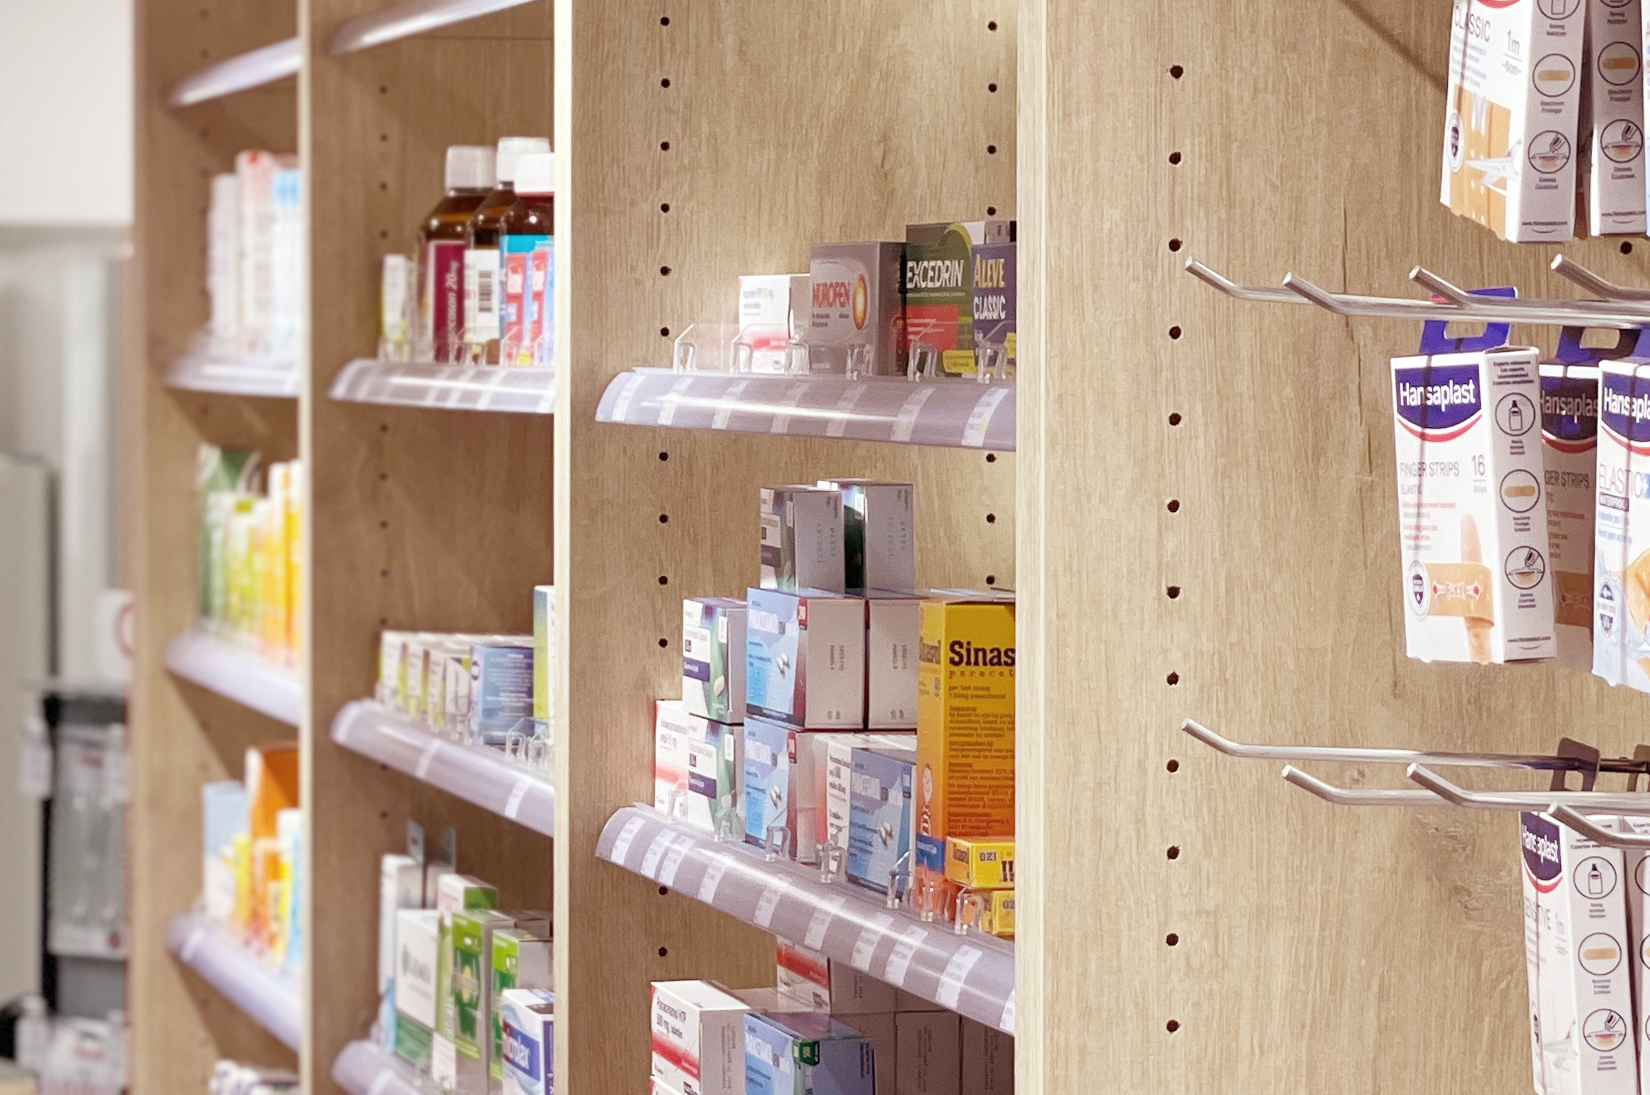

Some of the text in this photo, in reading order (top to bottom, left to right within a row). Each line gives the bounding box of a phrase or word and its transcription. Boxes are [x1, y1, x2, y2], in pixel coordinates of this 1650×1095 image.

[906, 260, 964, 289] EXCEDRIN
[973, 295, 1006, 320] CLASSIC
[1400, 379, 1476, 411] Hansaplast
[1540, 389, 1598, 424] Hansaplas
[1429, 461, 1460, 477] STRIPS
[1471, 454, 1486, 477] 16
[1545, 469, 1560, 486] GER
